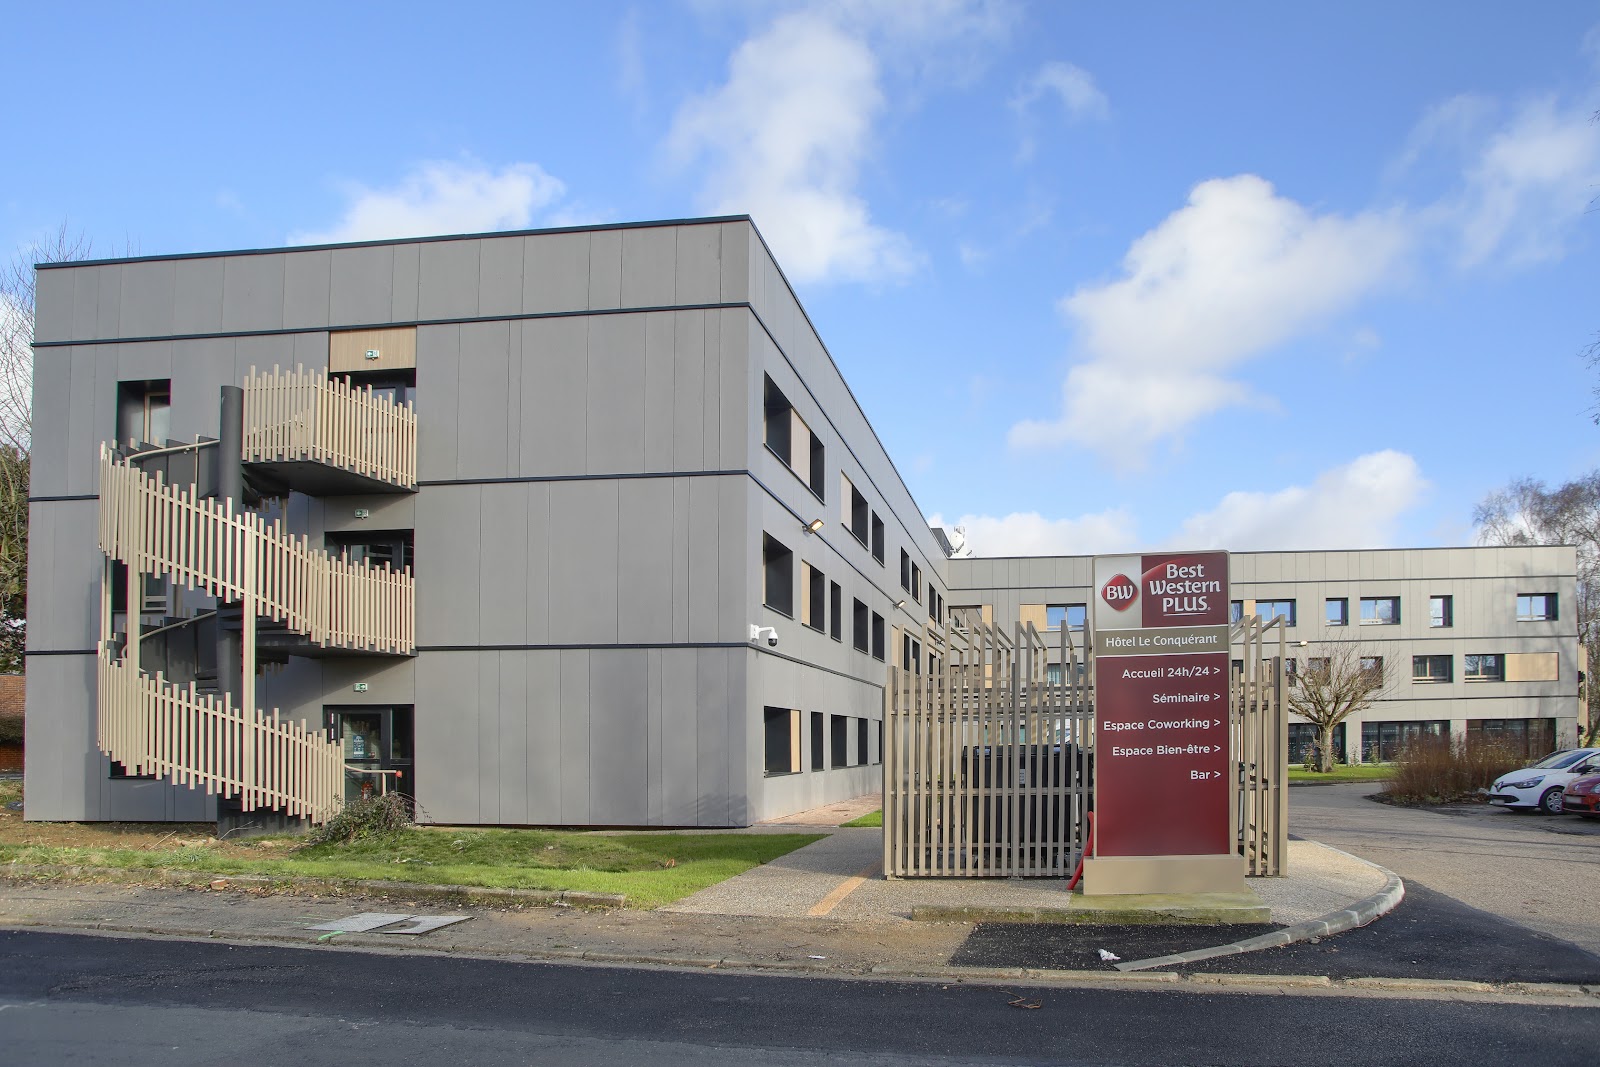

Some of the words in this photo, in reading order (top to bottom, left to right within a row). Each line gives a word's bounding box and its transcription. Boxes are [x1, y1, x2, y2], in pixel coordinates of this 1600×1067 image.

[1166, 564, 1204, 579] Best
[1107, 585, 1133, 600] BW
[1150, 580, 1221, 595] Western
[1163, 596, 1208, 612] PLUS
[1106, 637, 1135, 647] Hôtel
[1139, 637, 1150, 646] Le
[1154, 634, 1217, 647] Conquérant
[1122, 668, 1164, 678] Accueil
[1167, 666, 1209, 677] 24h/24
[1153, 693, 1210, 703] Séminaire
[1104, 721, 1144, 732] Espace
[1148, 719, 1209, 729] Coworking
[1113, 747, 1153, 757] Espace
[1157, 744, 1210, 755] Bien-être
[1191, 770, 1210, 779] Bar
